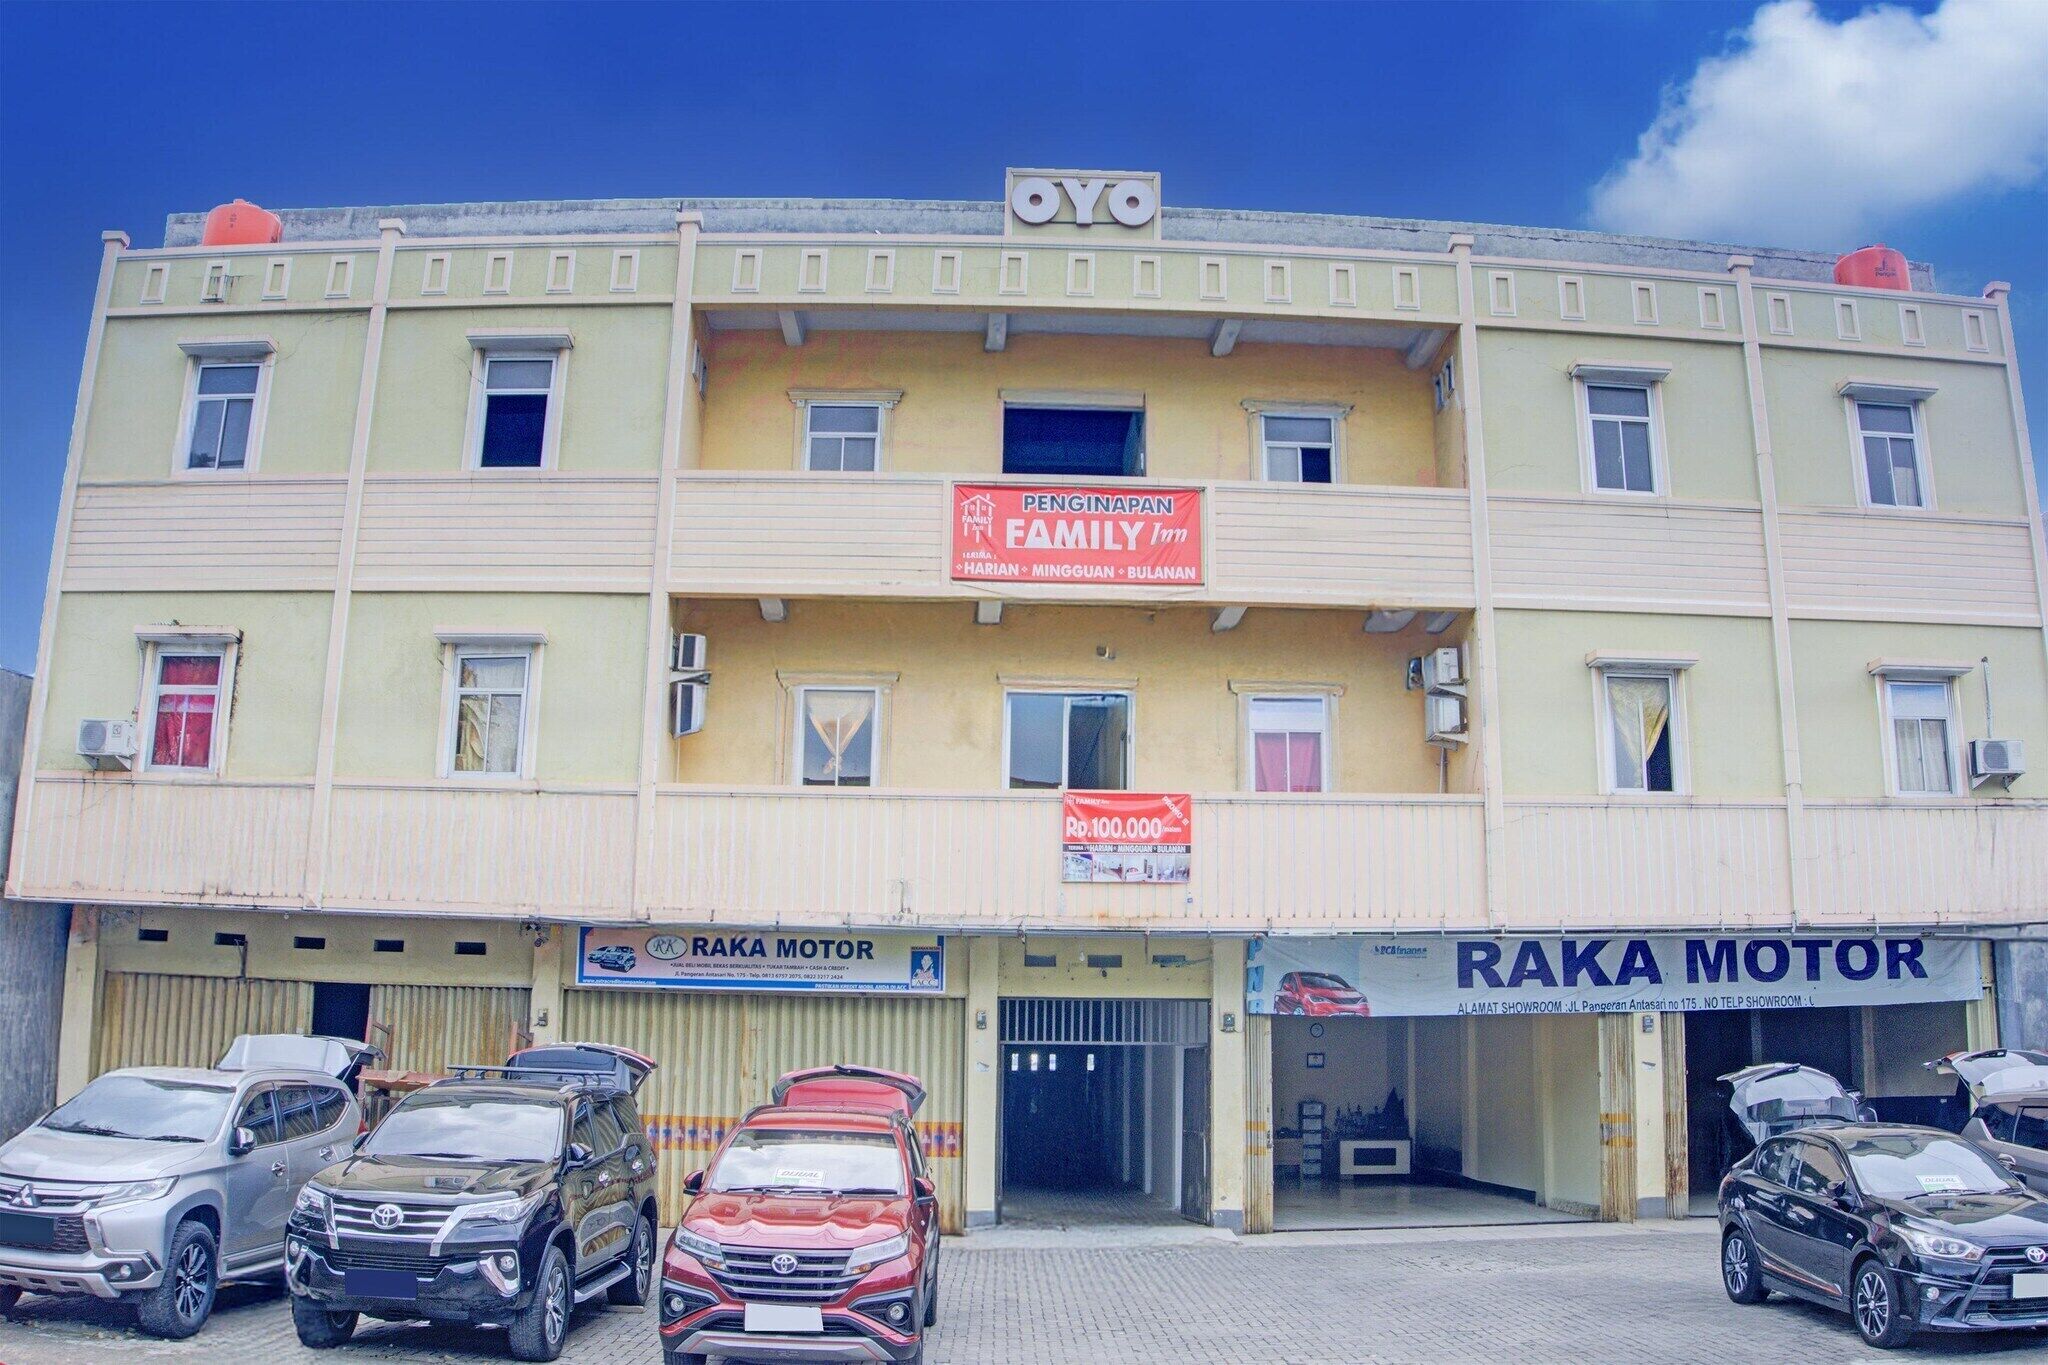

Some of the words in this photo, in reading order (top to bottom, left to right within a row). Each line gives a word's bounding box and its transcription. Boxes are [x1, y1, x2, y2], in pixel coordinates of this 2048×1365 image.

[1012, 177, 1156, 227] OYO
[1023, 494, 1173, 515] PENGINAPAN
[962, 515, 994, 524] FAMILY
[1006, 518, 1145, 551] FAMILY
[1150, 522, 1188, 546] Inn
[964, 562, 1019, 576] HARIAN
[1032, 564, 1115, 578] MINGGUAN
[1127, 566, 1196, 580] BULANAN
[1162, 796, 1183, 819] PROMO
[1065, 816, 1161, 839] Rp.100.000
[1118, 845, 1153, 853] MINGGUAN
[1157, 845, 1186, 853] BULANAN
[692, 937, 767, 958] RAKA
[776, 938, 874, 960] MOTOR
[1457, 940, 1663, 988] RAKA
[1685, 939, 1929, 984] MOTOR
[1457, 1001, 1498, 1015] ALAMAT
[1501, 1000, 1562, 1015] SHOWROOM
[1582, 1001, 1627, 1014] Pangeran
[1629, 998, 1667, 1011] Antasari
[1668, 1002, 1679, 1011] no
[1681, 997, 1697, 1010] 175
[1704, 997, 1719, 1009] NO
[1720, 996, 1744, 1009] TELP
[1746, 995, 1803, 1008] SHOWROOM
